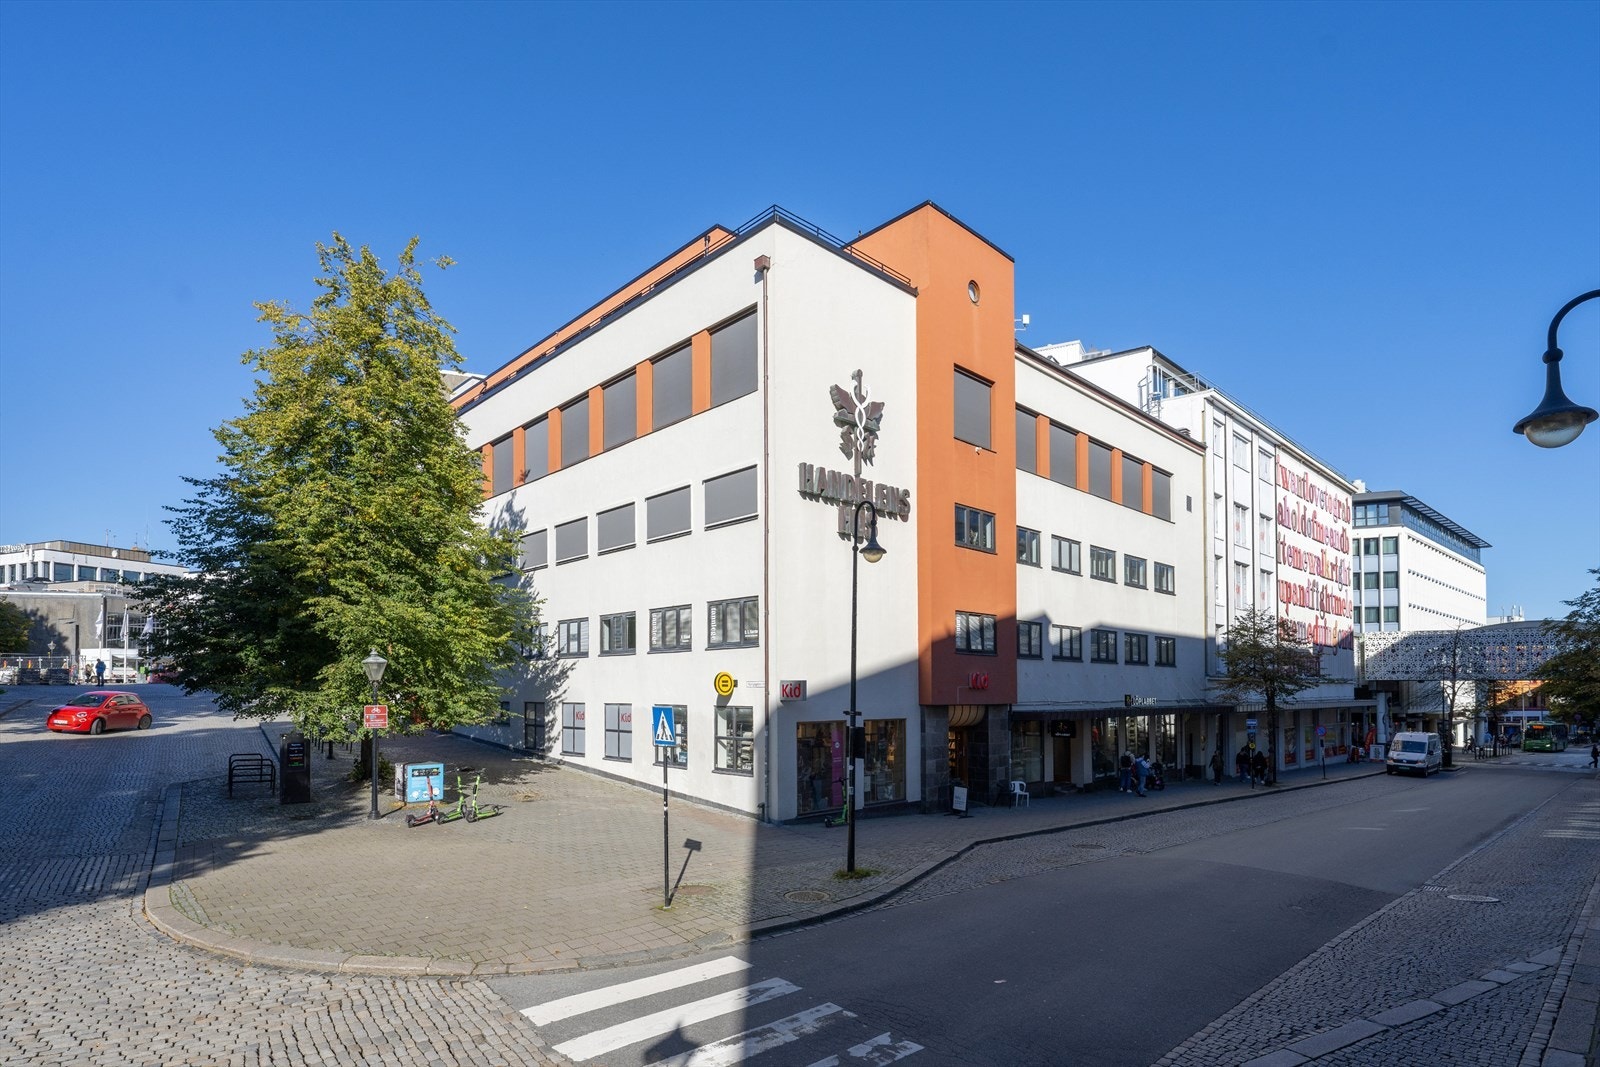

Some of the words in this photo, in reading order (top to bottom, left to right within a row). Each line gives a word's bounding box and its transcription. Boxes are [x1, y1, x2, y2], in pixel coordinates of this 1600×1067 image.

[798, 462, 911, 522] HANDELENS
[969, 672, 989, 690] Kid
[781, 683, 802, 699] Kid
[575, 711, 585, 721] Kid
[620, 712, 632, 723] Kid
